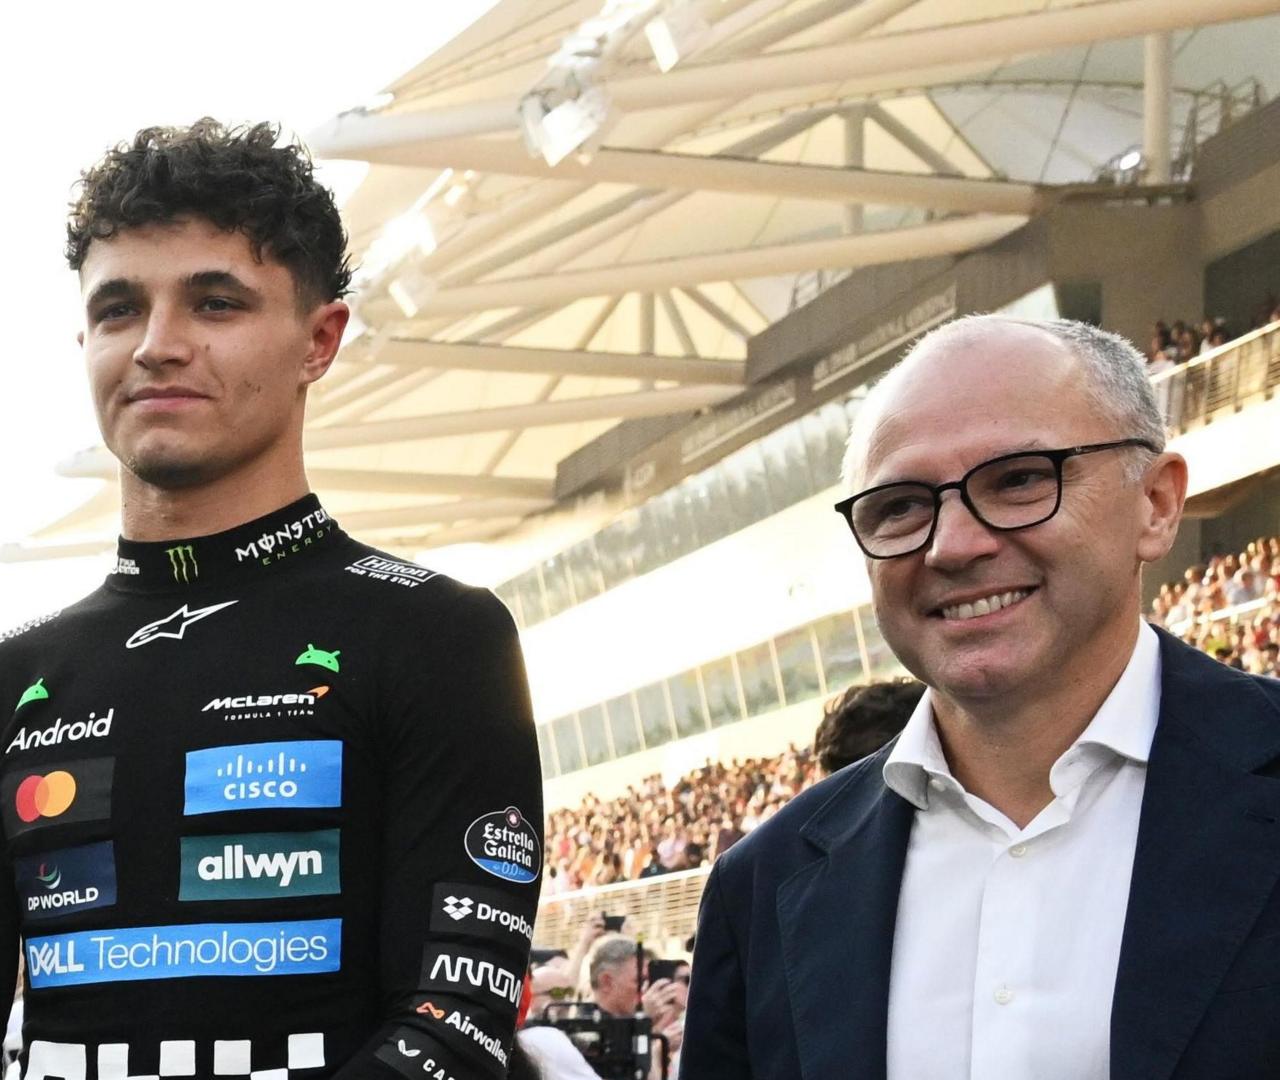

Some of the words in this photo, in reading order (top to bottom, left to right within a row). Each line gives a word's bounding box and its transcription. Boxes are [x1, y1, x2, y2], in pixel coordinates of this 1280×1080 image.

[345, 565, 366, 576] FOR
[368, 571, 388, 582] THE
[389, 576, 421, 588] STAY
[363, 557, 429, 579] Hilton
[201, 691, 316, 712] McLaren
[224, 711, 271, 721] FORMULA
[287, 709, 314, 718] TEAM
[5, 708, 115, 754] Android
[481, 822, 535, 852] Estrella
[197, 844, 323, 888] allwyn
[483, 839, 532, 868] Galicia
[27, 896, 41, 911] DP
[41, 886, 100, 907] WORLD
[28, 939, 85, 978] DELL
[90, 930, 329, 973] Technologies
[444, 1010, 509, 1068] Airwallex
